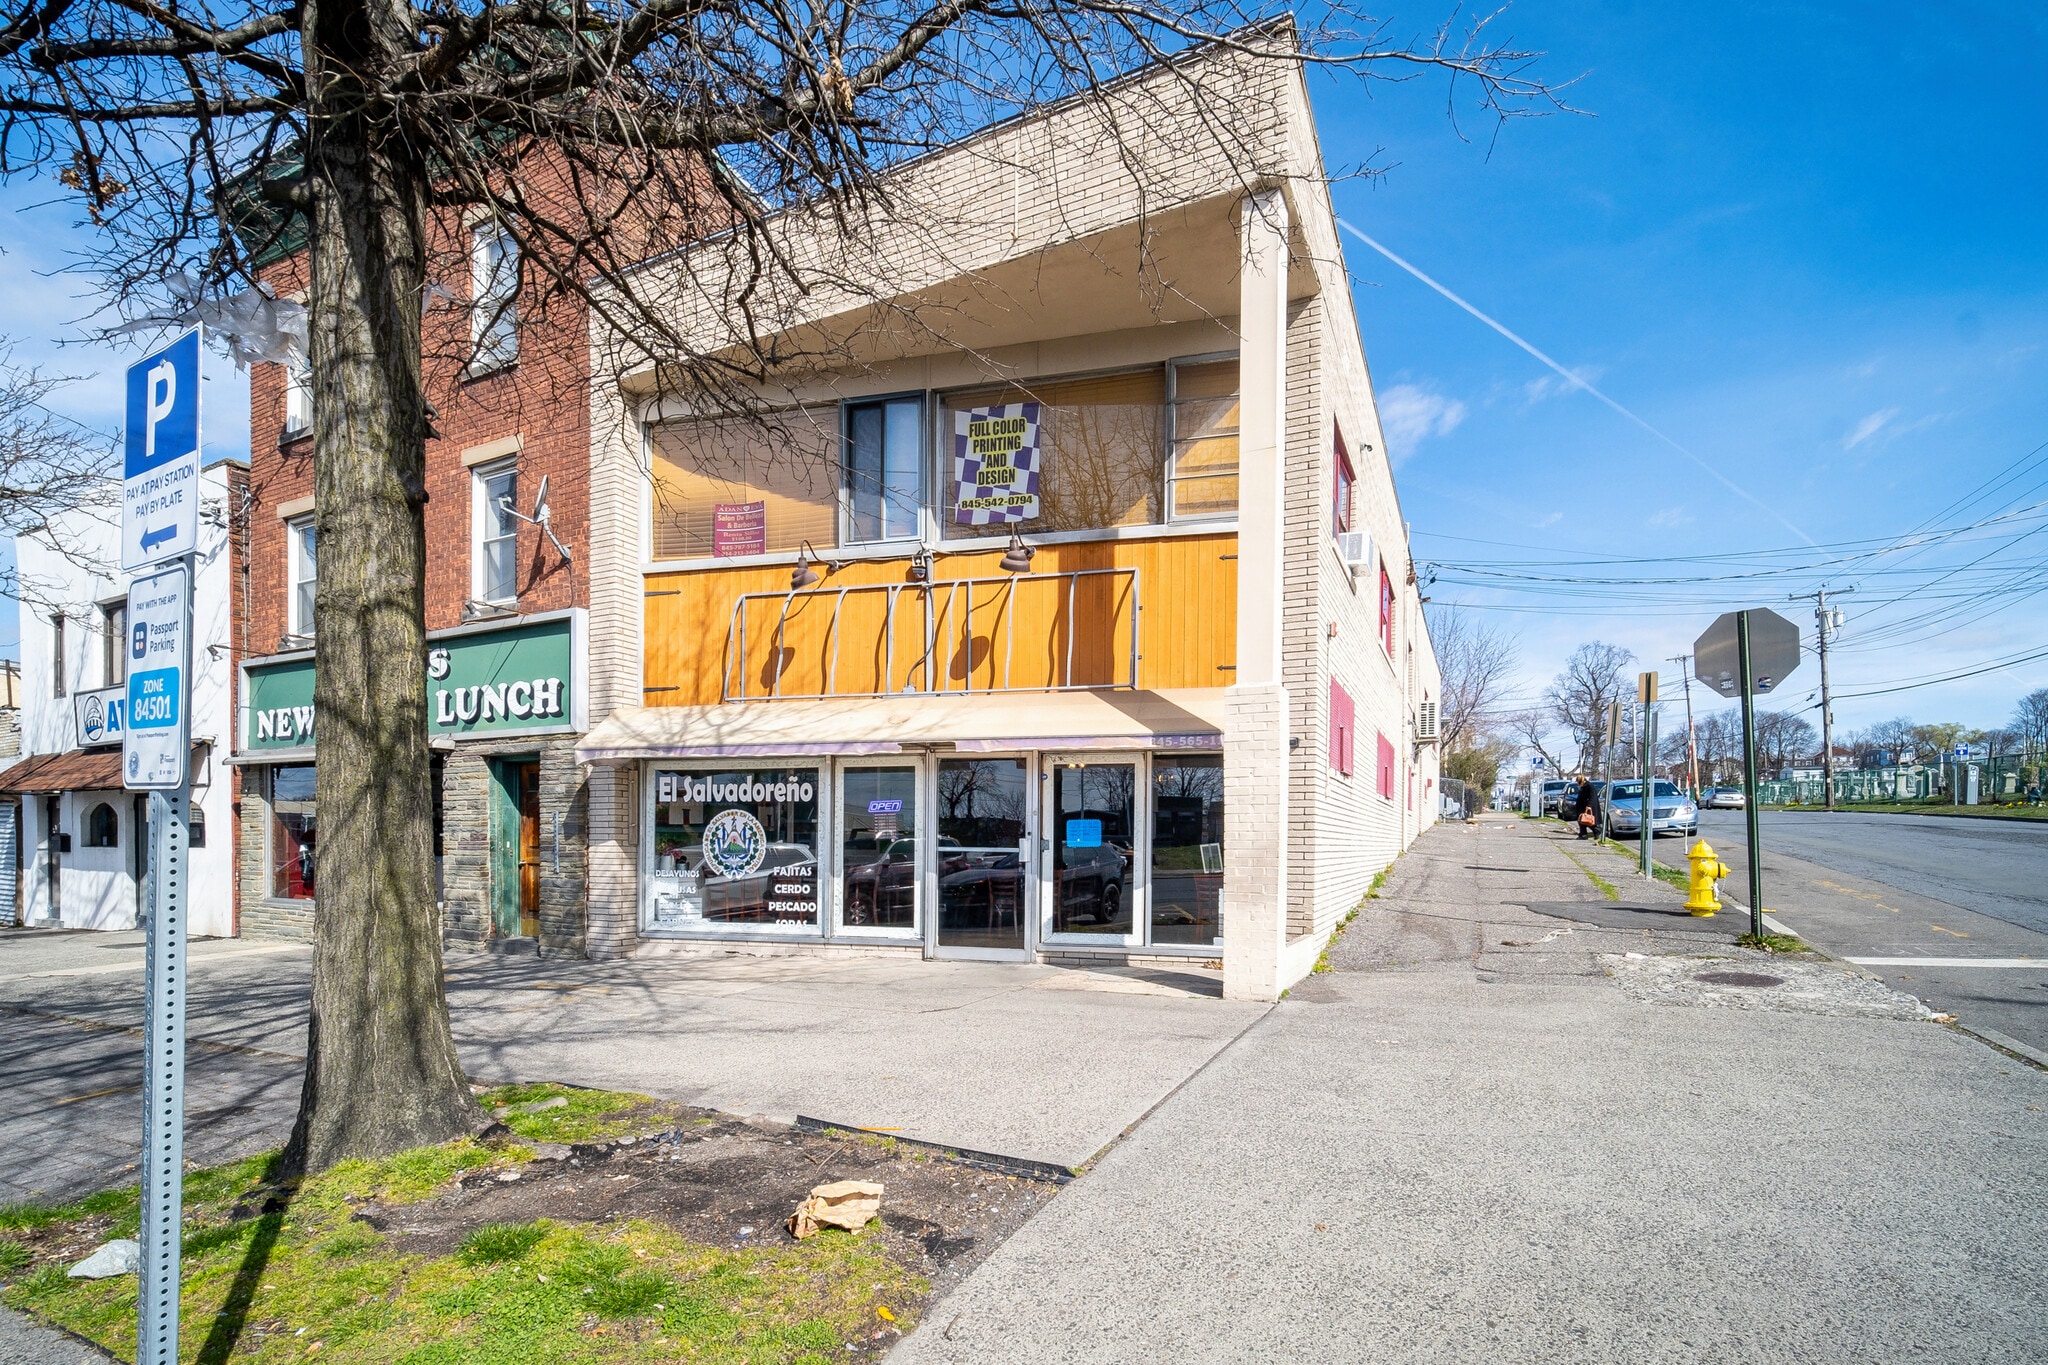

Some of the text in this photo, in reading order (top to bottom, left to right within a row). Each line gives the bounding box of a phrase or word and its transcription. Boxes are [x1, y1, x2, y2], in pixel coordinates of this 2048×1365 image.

[145, 361, 177, 457] P
[969, 418, 1026, 438] FULL COLOR
[973, 435, 1021, 454] PRINTING
[986, 453, 1007, 469] AND
[126, 463, 194, 502] PAY AT PAY STATION
[978, 468, 1016, 486] DESIGN
[136, 489, 183, 519] PAY BY PLATE
[961, 495, 1034, 509] 845-542-0794
[136, 594, 177, 611] PAY WITH THE APP
[150, 620, 179, 637] Passport
[149, 639, 175, 653] Parking
[143, 678, 164, 694] ZONE
[134, 694, 172, 722] 84501
[435, 677, 562, 726] LUNCH
[659, 775, 813, 803] El Salvadoreño
[870, 802, 900, 811] OPEN
[655, 870, 700, 878] DESAYUNOS
[773, 866, 812, 877] FAJITAS
[774, 884, 811, 894] CERDO
[768, 902, 817, 913] PESCADO
